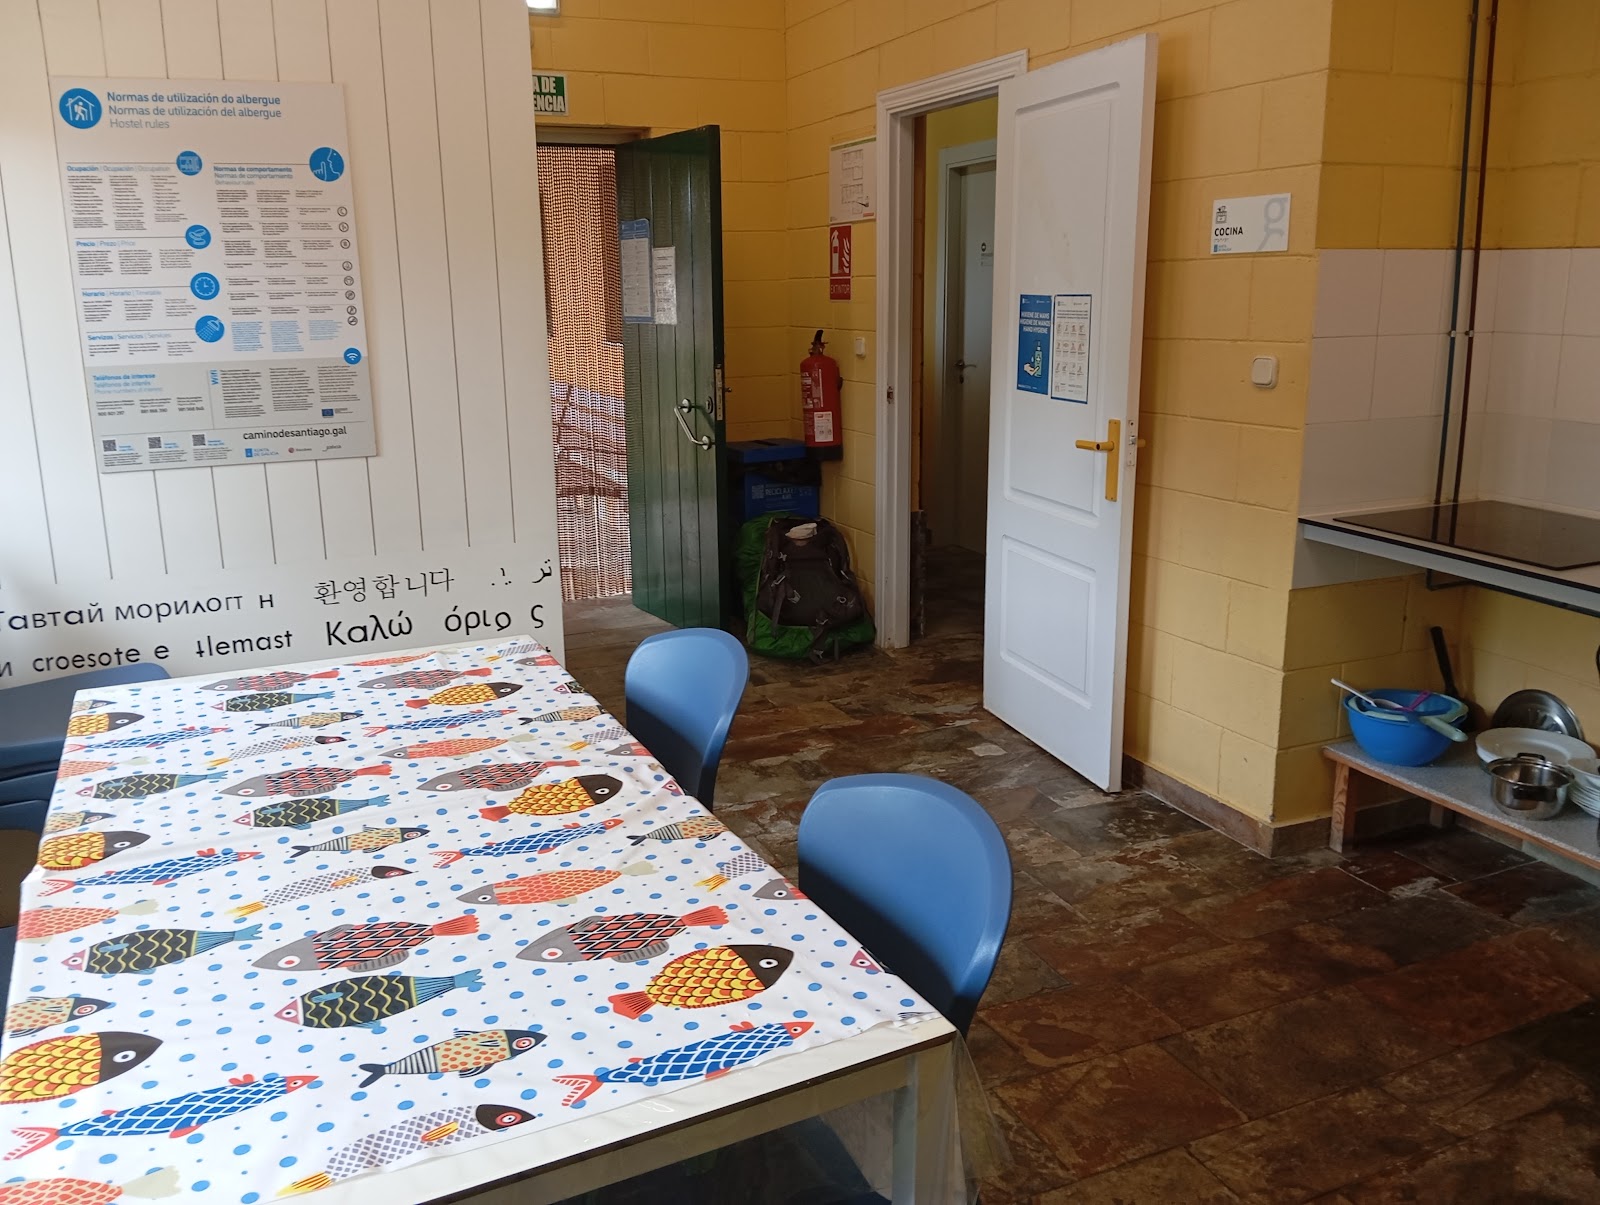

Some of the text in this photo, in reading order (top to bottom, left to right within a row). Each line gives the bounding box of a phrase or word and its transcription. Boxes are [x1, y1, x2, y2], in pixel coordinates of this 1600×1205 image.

[541, 77, 556, 93] DE
[107, 92, 280, 106] Normas de utilización do albergue
[109, 106, 281, 119] Normas de utilización del albergue
[110, 119, 169, 128] Hostel rules
[1215, 227, 1243, 236] COCINA
[243, 426, 347, 439] caminodesantiago.gal
[154, 645, 169, 659] e
